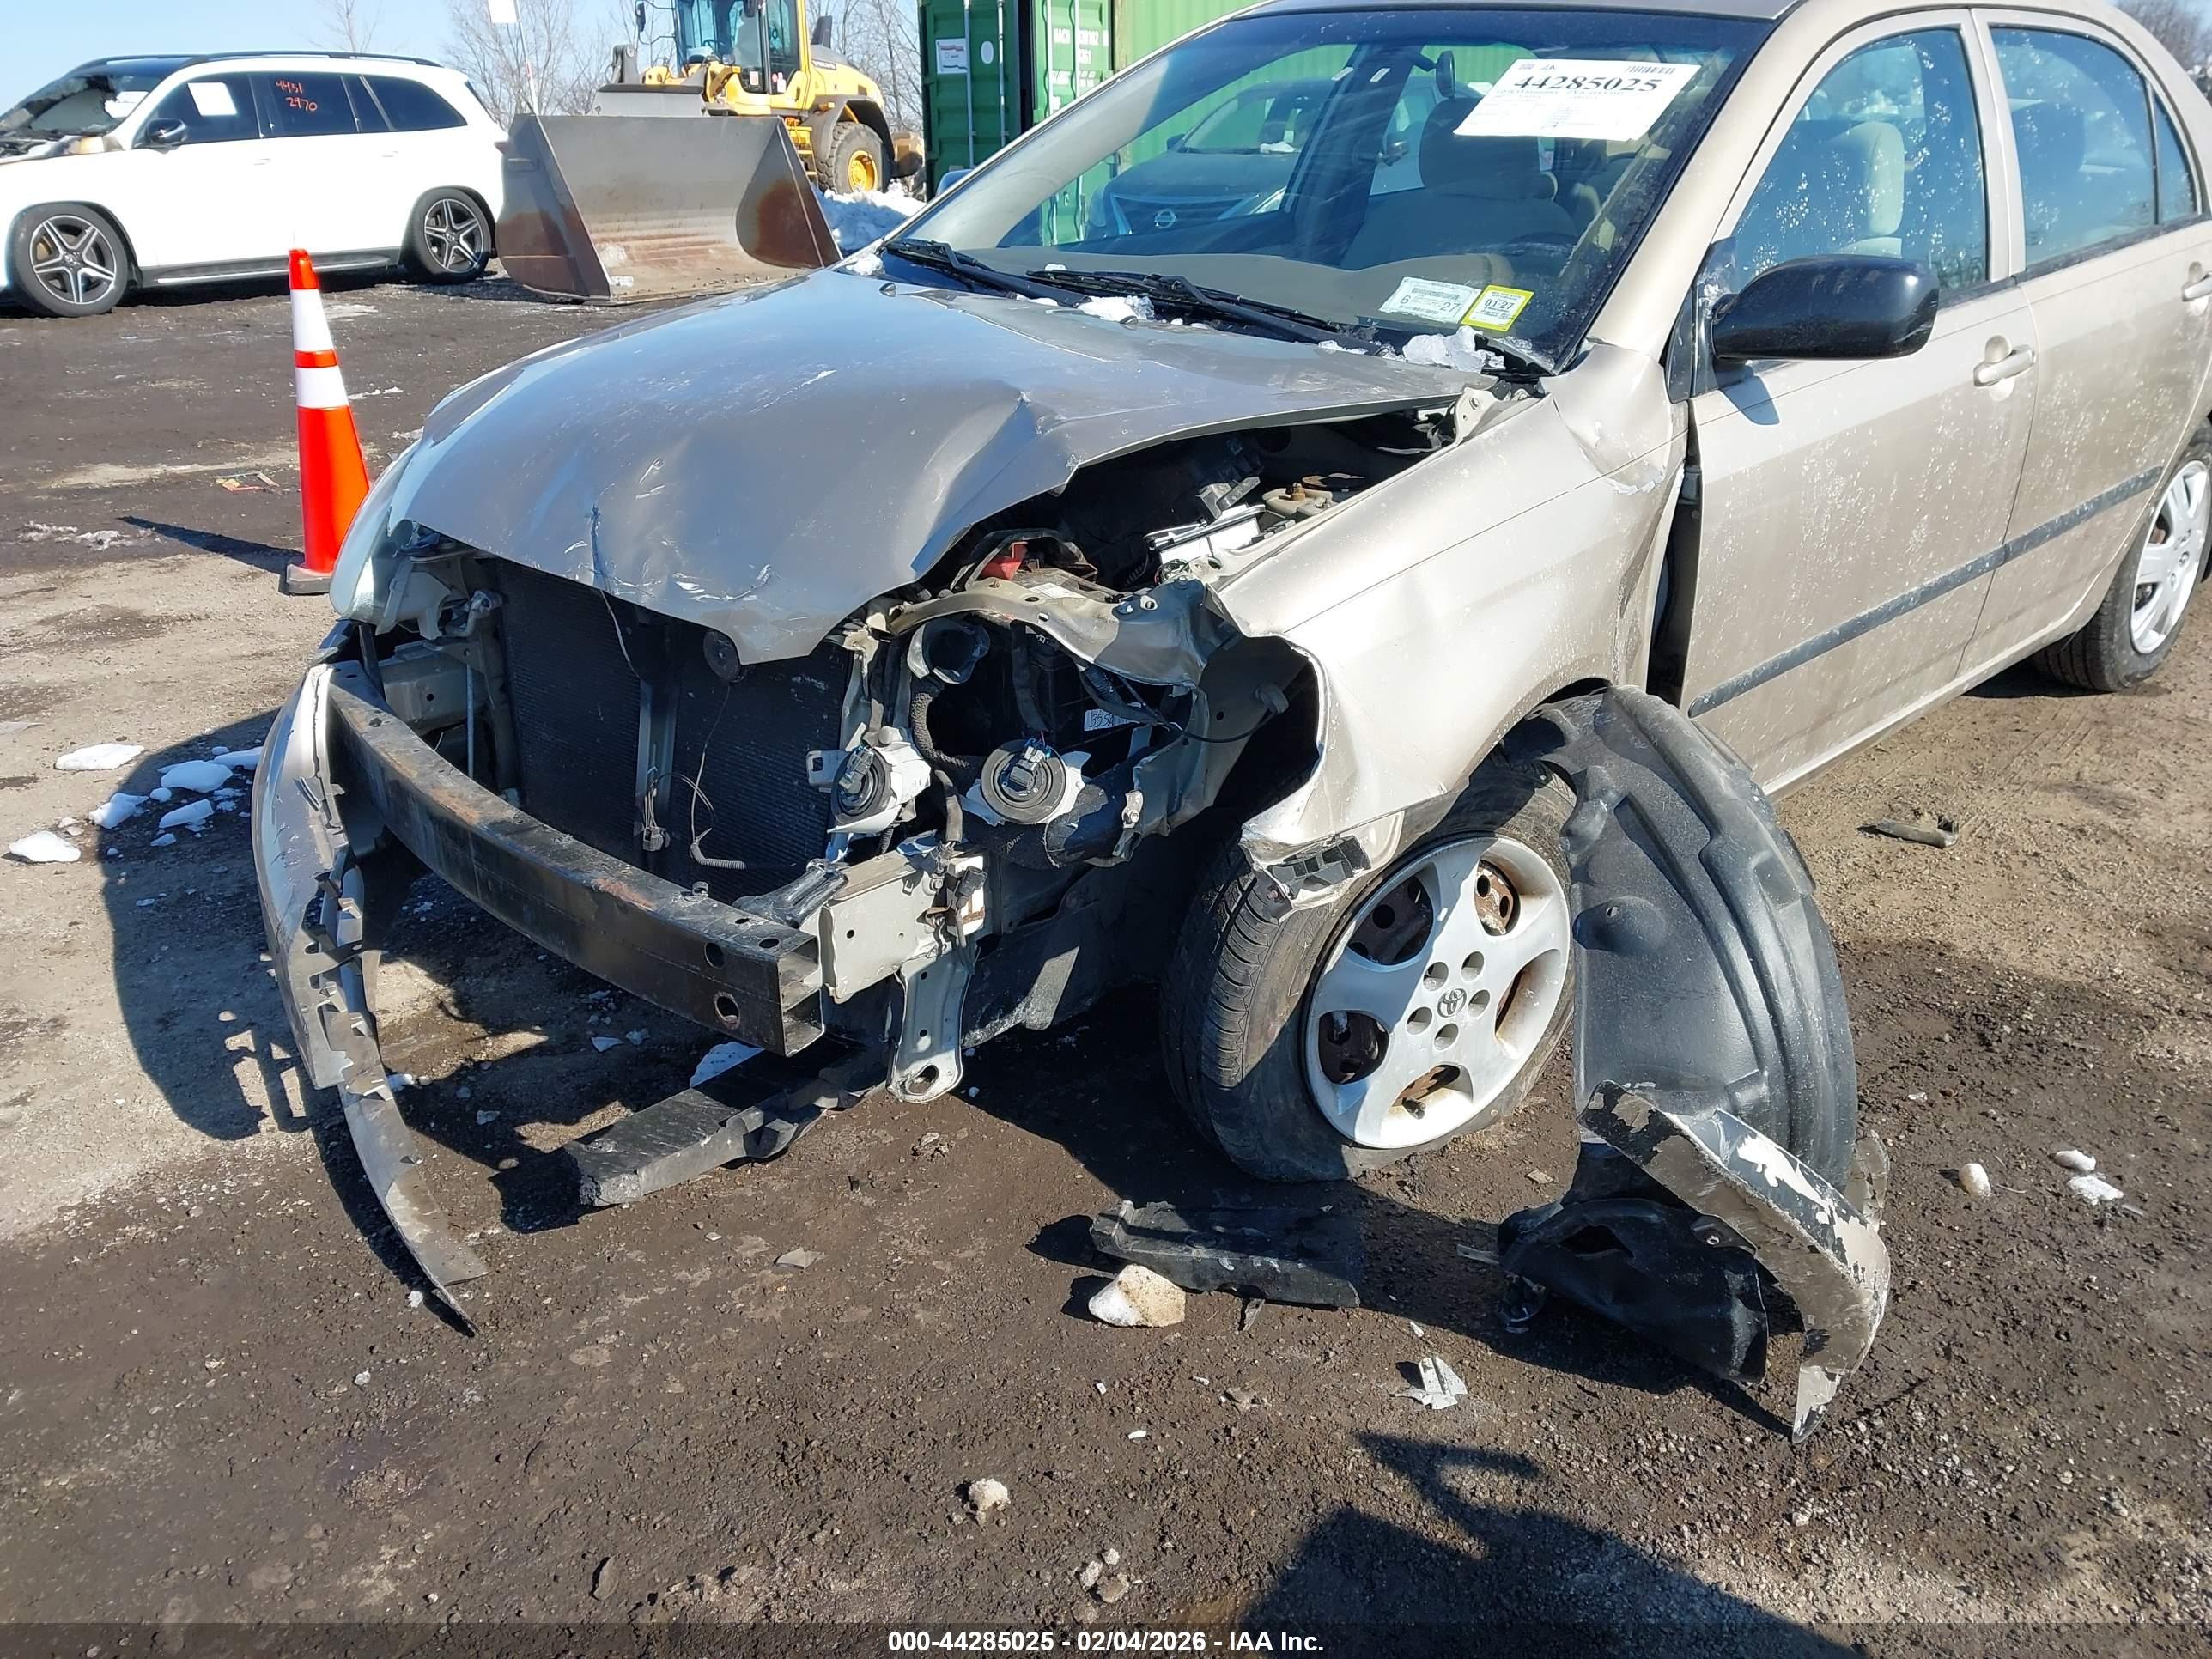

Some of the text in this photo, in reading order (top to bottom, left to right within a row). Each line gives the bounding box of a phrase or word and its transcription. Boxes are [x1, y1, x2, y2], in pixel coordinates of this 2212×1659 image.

[275, 80, 303, 94] 4451
[1514, 76, 1662, 92] 44285025
[285, 97, 318, 112] 2970
[1439, 301, 1462, 313] 27
